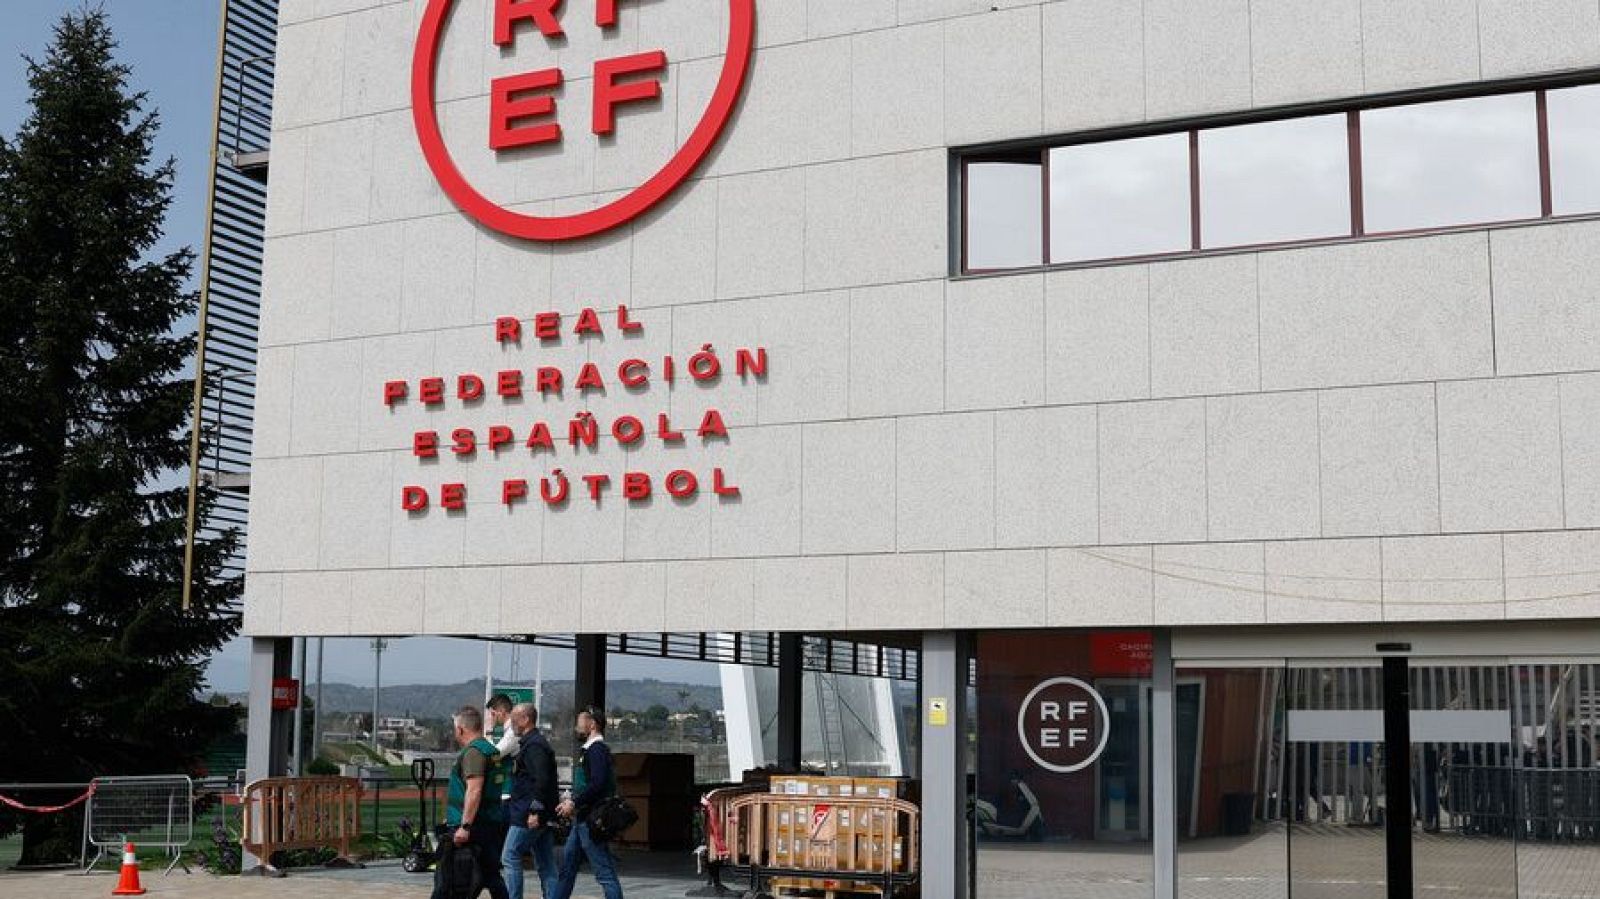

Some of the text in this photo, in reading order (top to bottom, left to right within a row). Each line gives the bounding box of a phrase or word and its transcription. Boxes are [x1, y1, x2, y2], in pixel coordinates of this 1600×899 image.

[489, 50, 668, 151] EF
[495, 304, 643, 343] REAL
[383, 343, 768, 406] FEDERACIÓN
[413, 411, 728, 458] ESPAÑOLA
[401, 468, 740, 511] DE FÚTBOL
[1040, 701, 1088, 720] RF
[1040, 728, 1088, 748] EF
